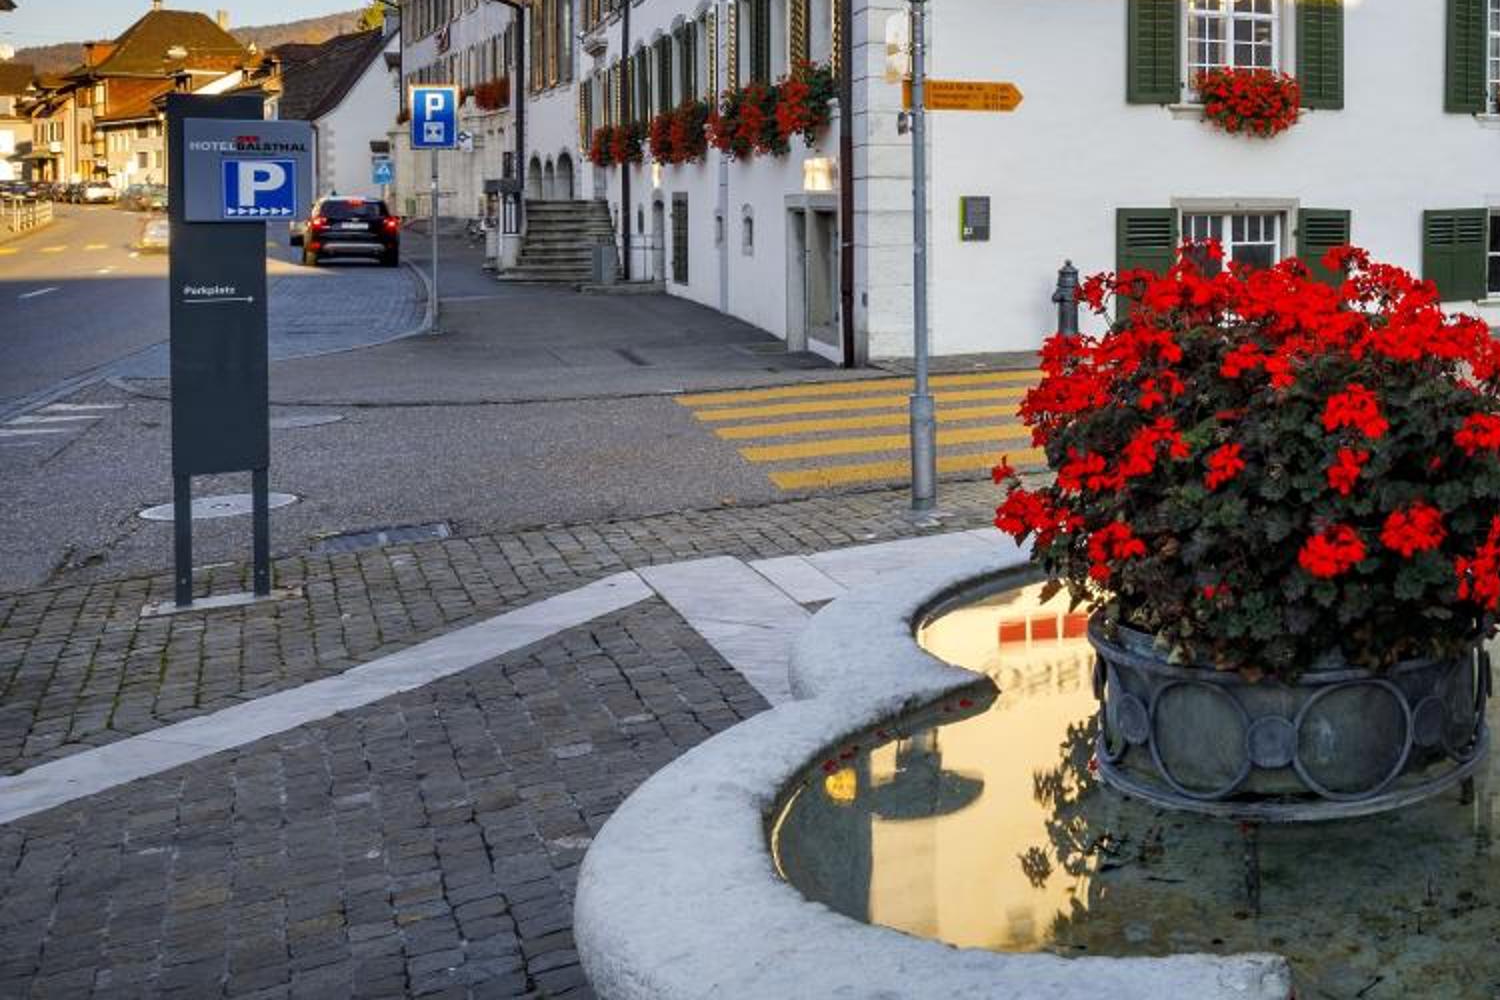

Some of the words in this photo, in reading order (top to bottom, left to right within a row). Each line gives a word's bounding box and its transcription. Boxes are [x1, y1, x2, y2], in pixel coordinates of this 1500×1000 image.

[425, 93, 445, 121] P
[238, 161, 287, 207] P
[183, 284, 236, 297] Parkplatz
